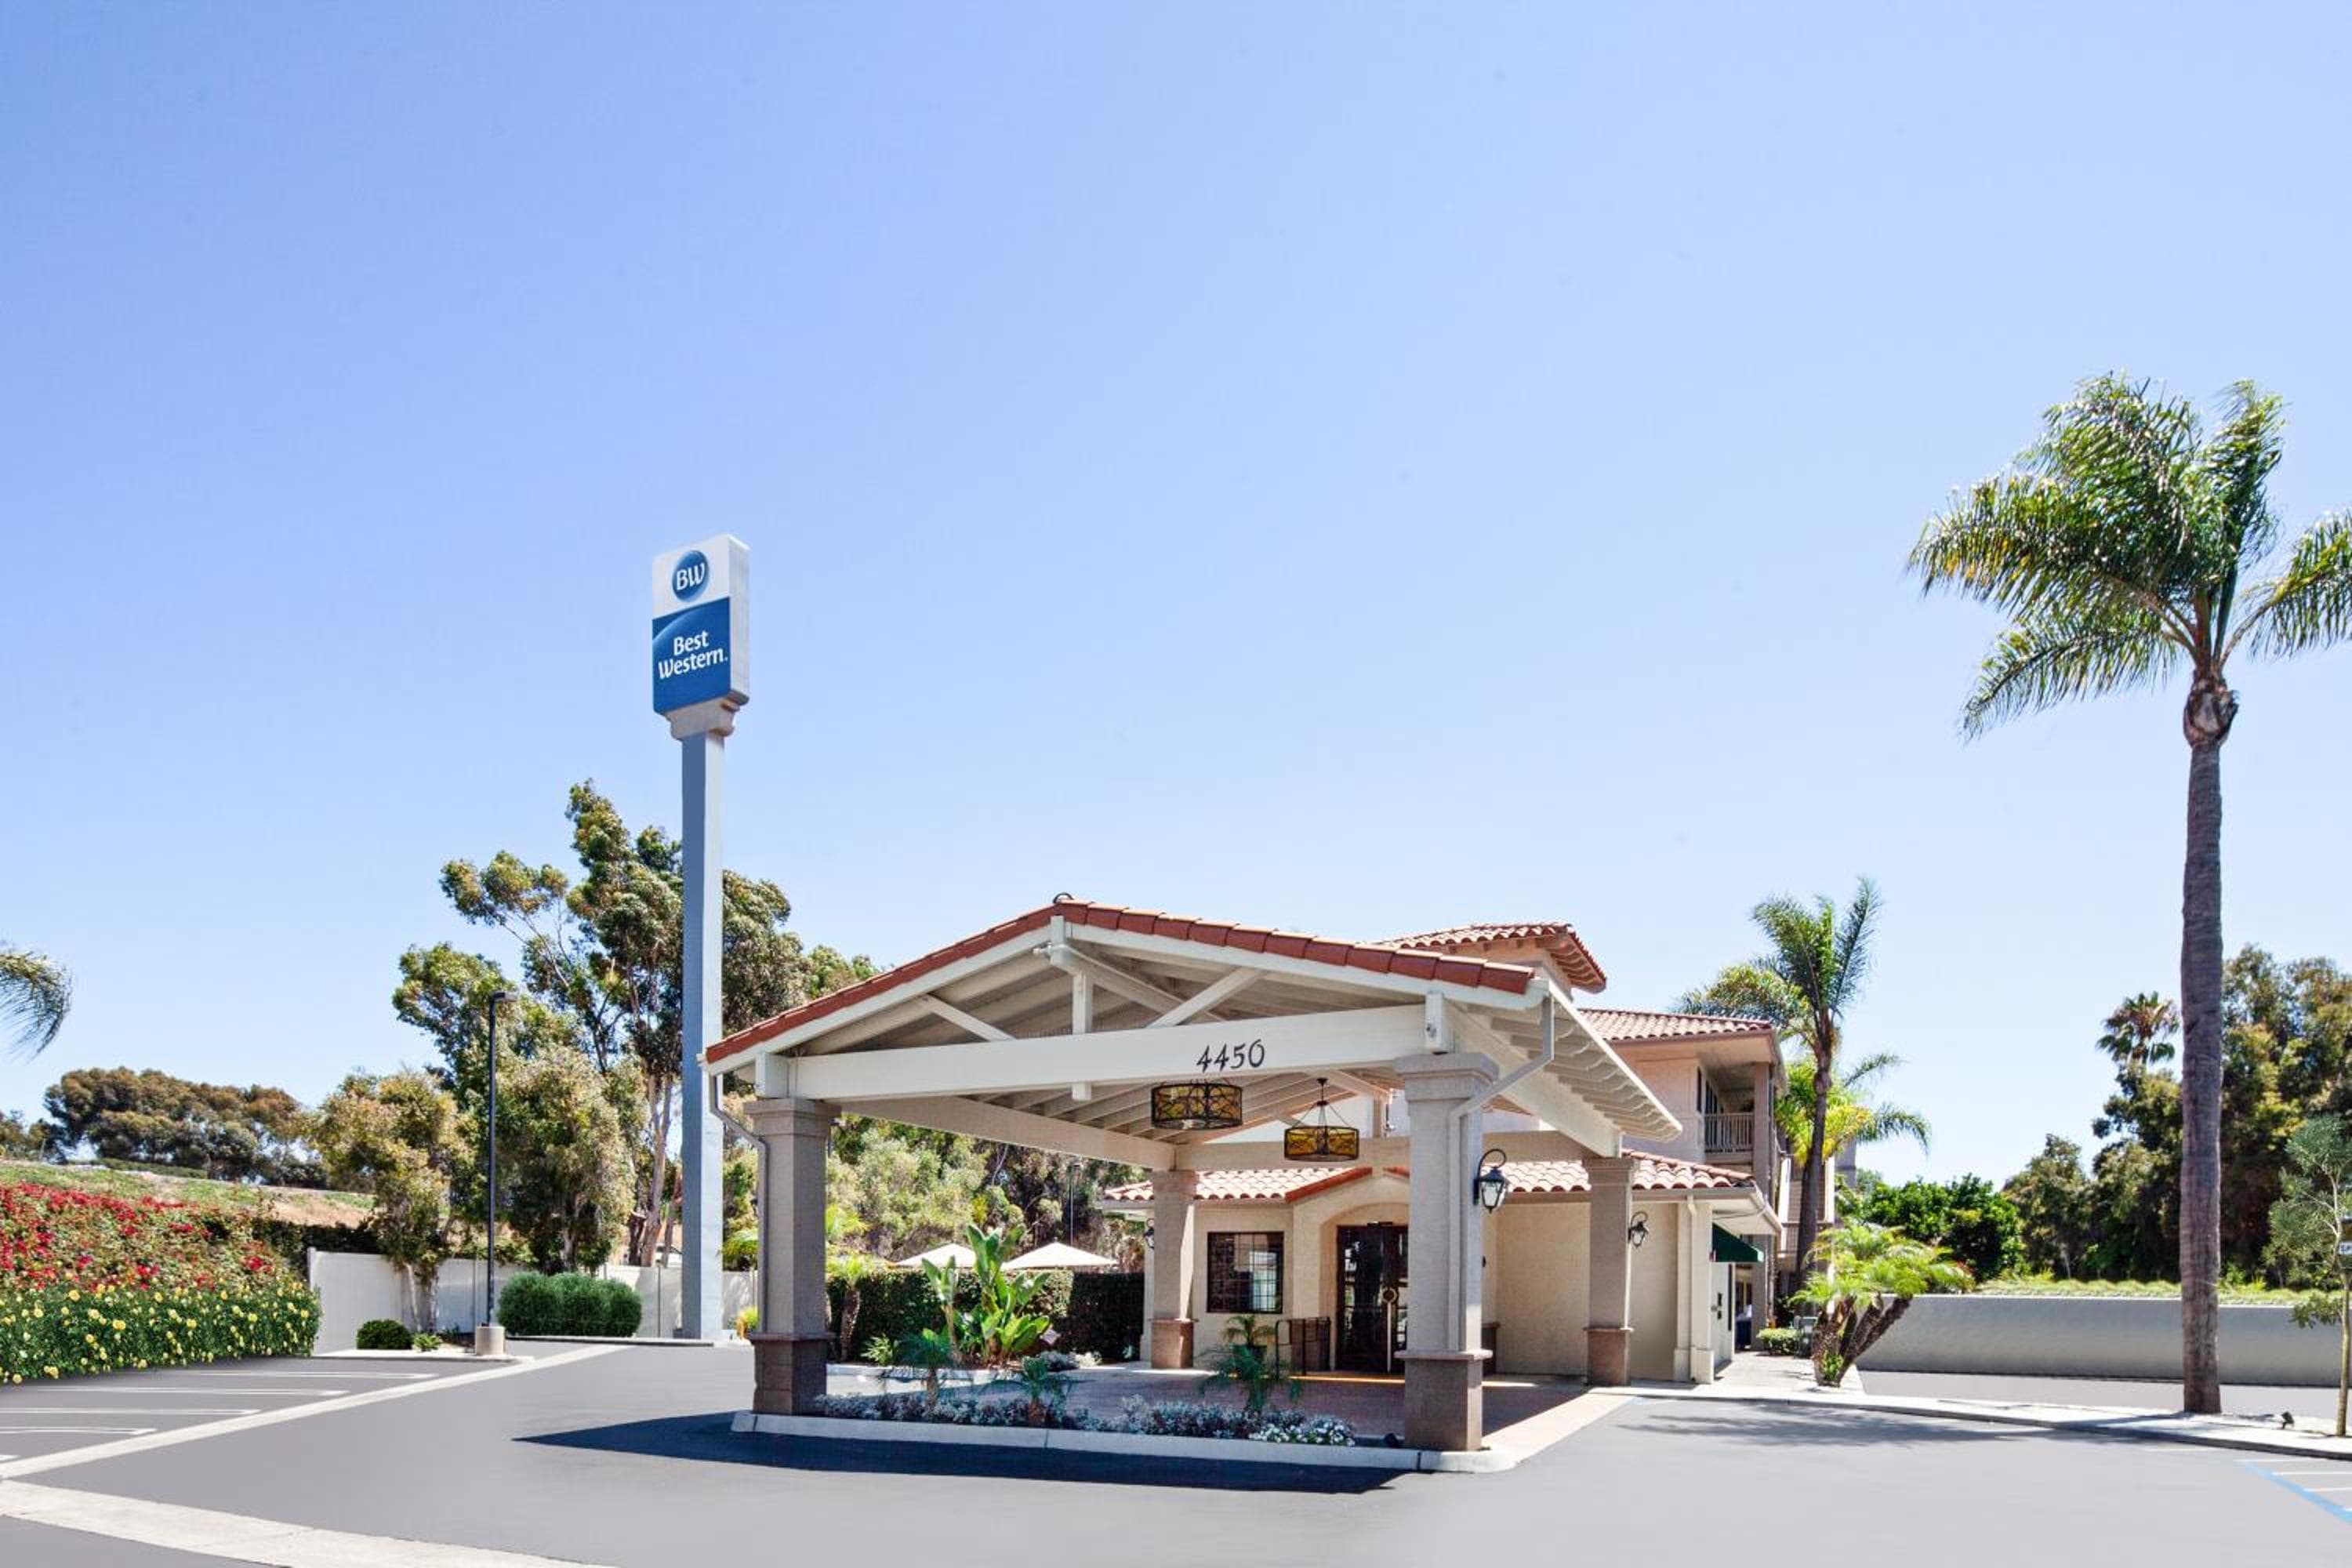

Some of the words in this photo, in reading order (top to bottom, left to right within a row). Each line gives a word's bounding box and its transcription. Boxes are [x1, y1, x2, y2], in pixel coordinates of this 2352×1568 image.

[677, 562, 705, 590] BW
[673, 630, 710, 656] Best
[1196, 1038, 1265, 1073] 4450
